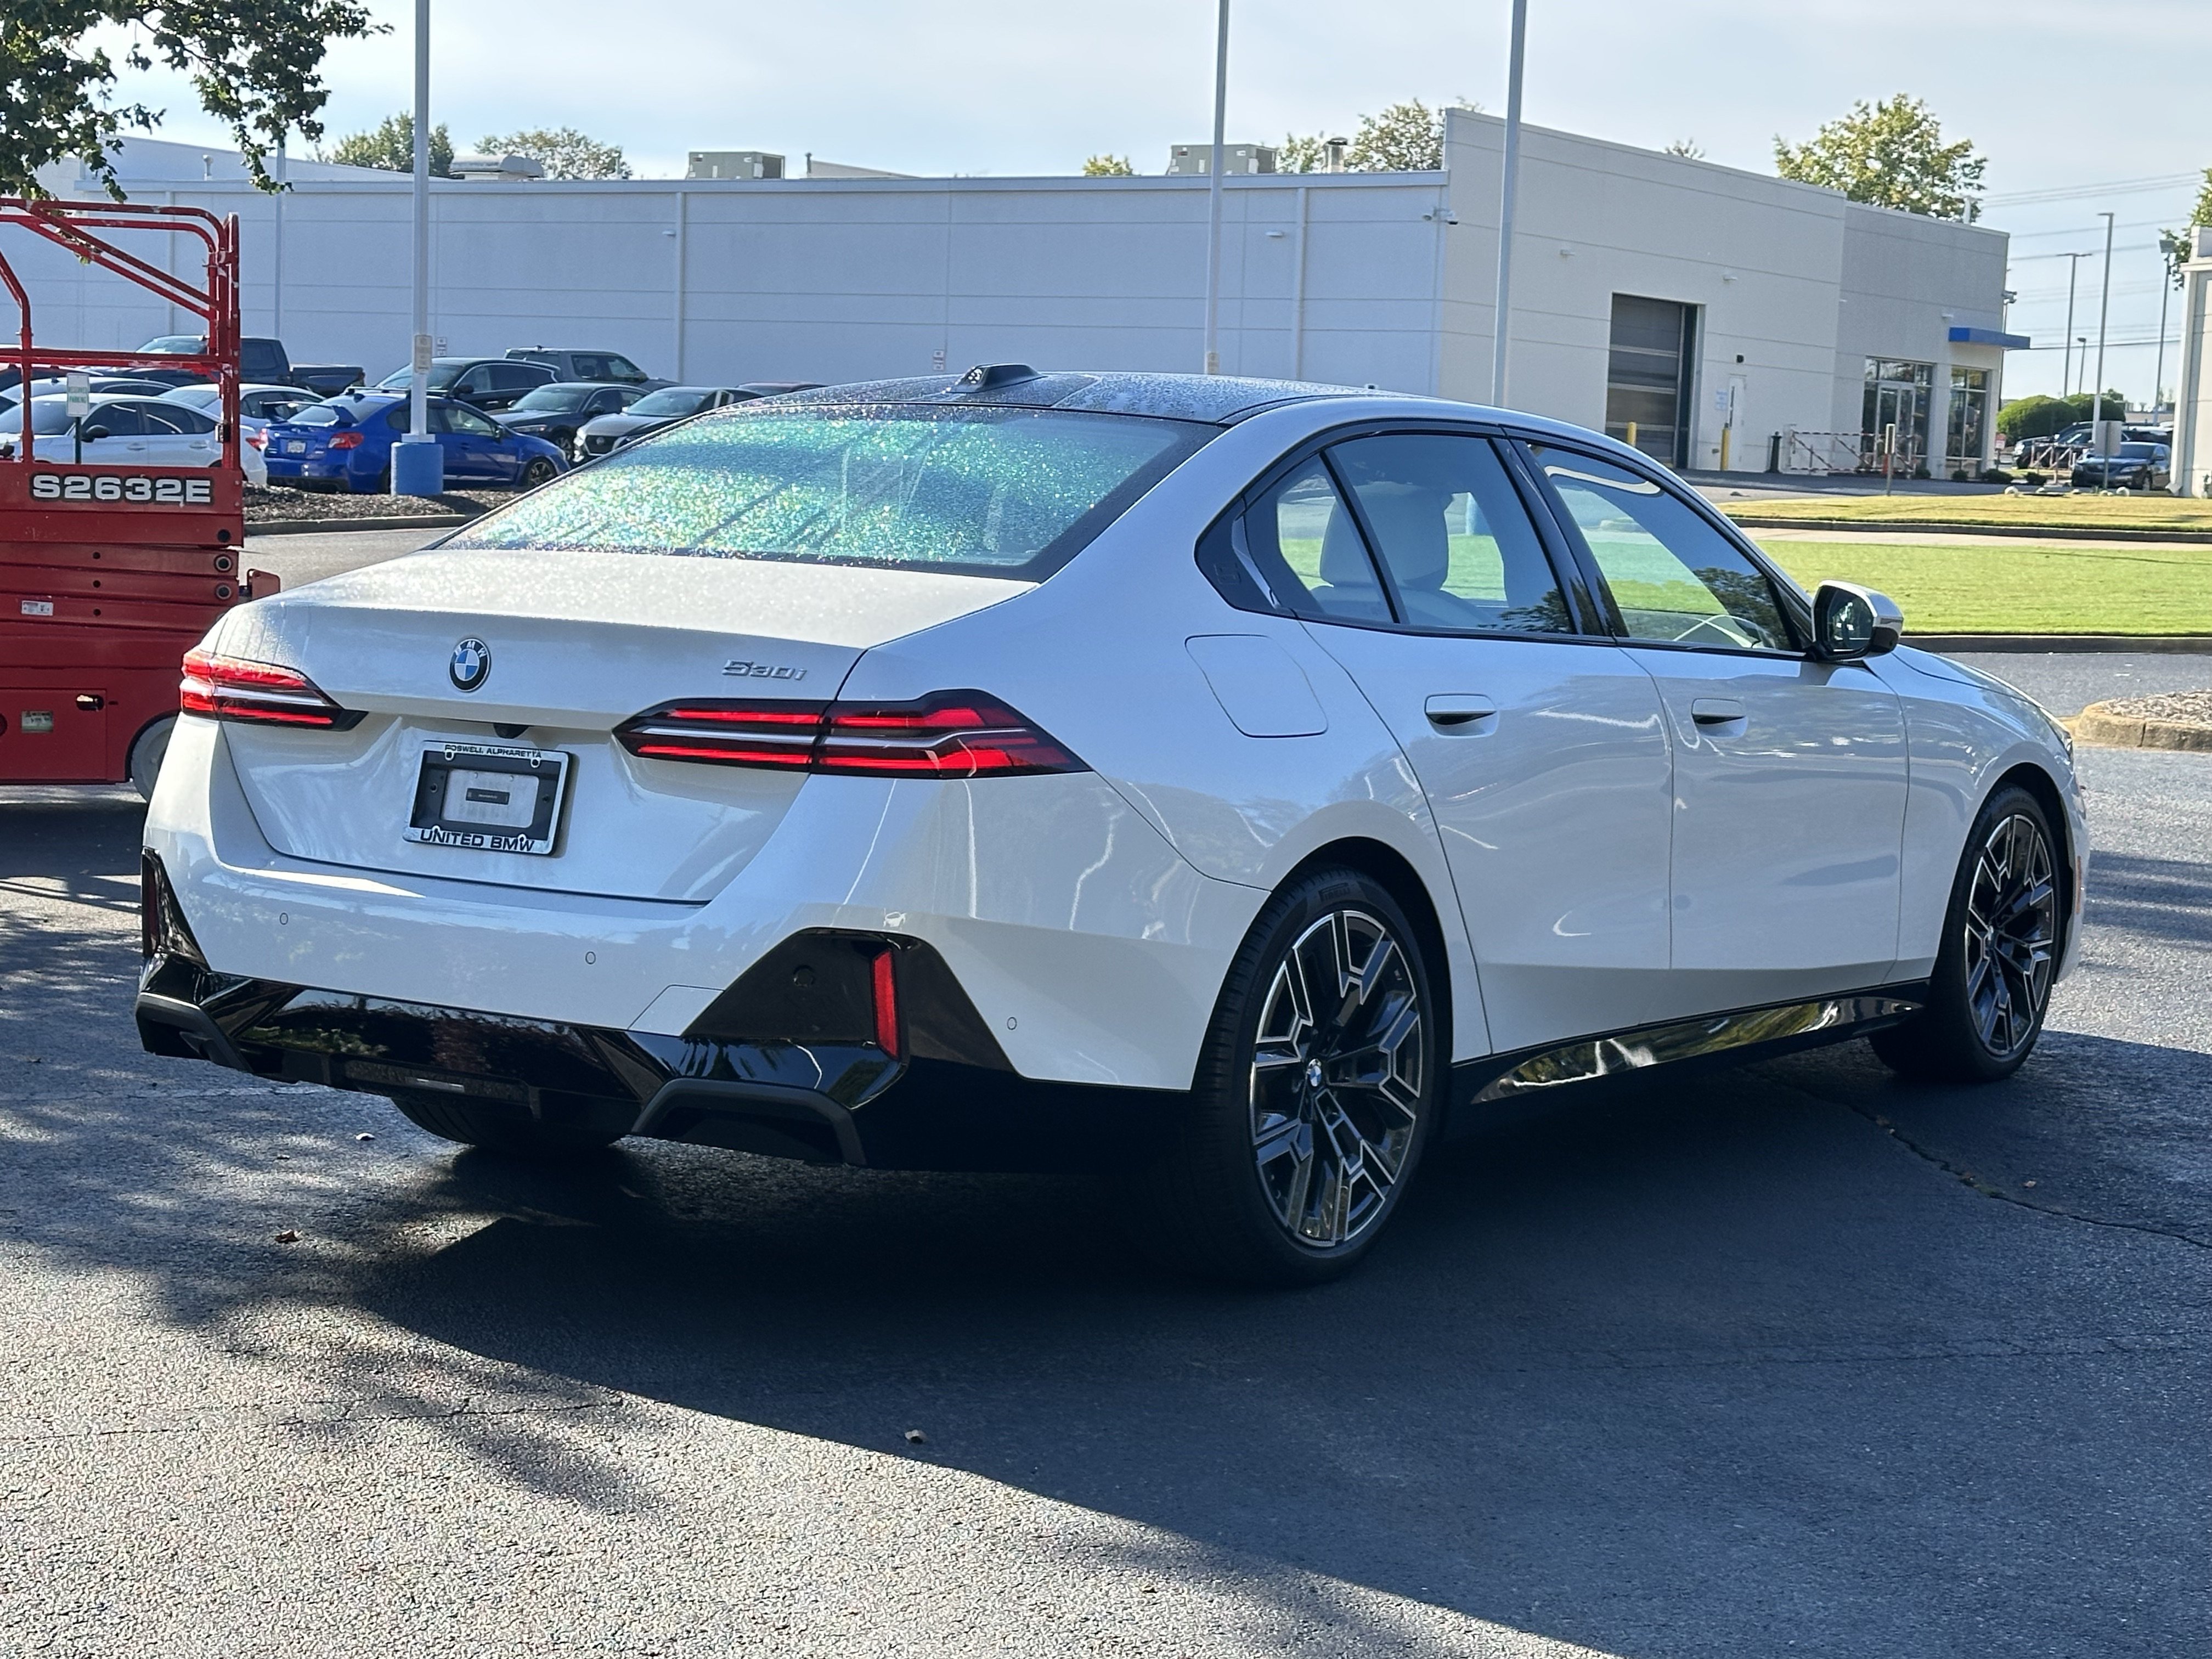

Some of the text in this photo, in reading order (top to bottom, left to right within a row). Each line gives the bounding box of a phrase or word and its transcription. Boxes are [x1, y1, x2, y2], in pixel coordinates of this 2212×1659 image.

[33, 475, 211, 503] S2632E
[454, 641, 487, 658] BMW
[721, 659, 808, 681] 530i
[487, 748, 541, 758] ALPHARETTA
[420, 829, 534, 851] UNITED BMW
